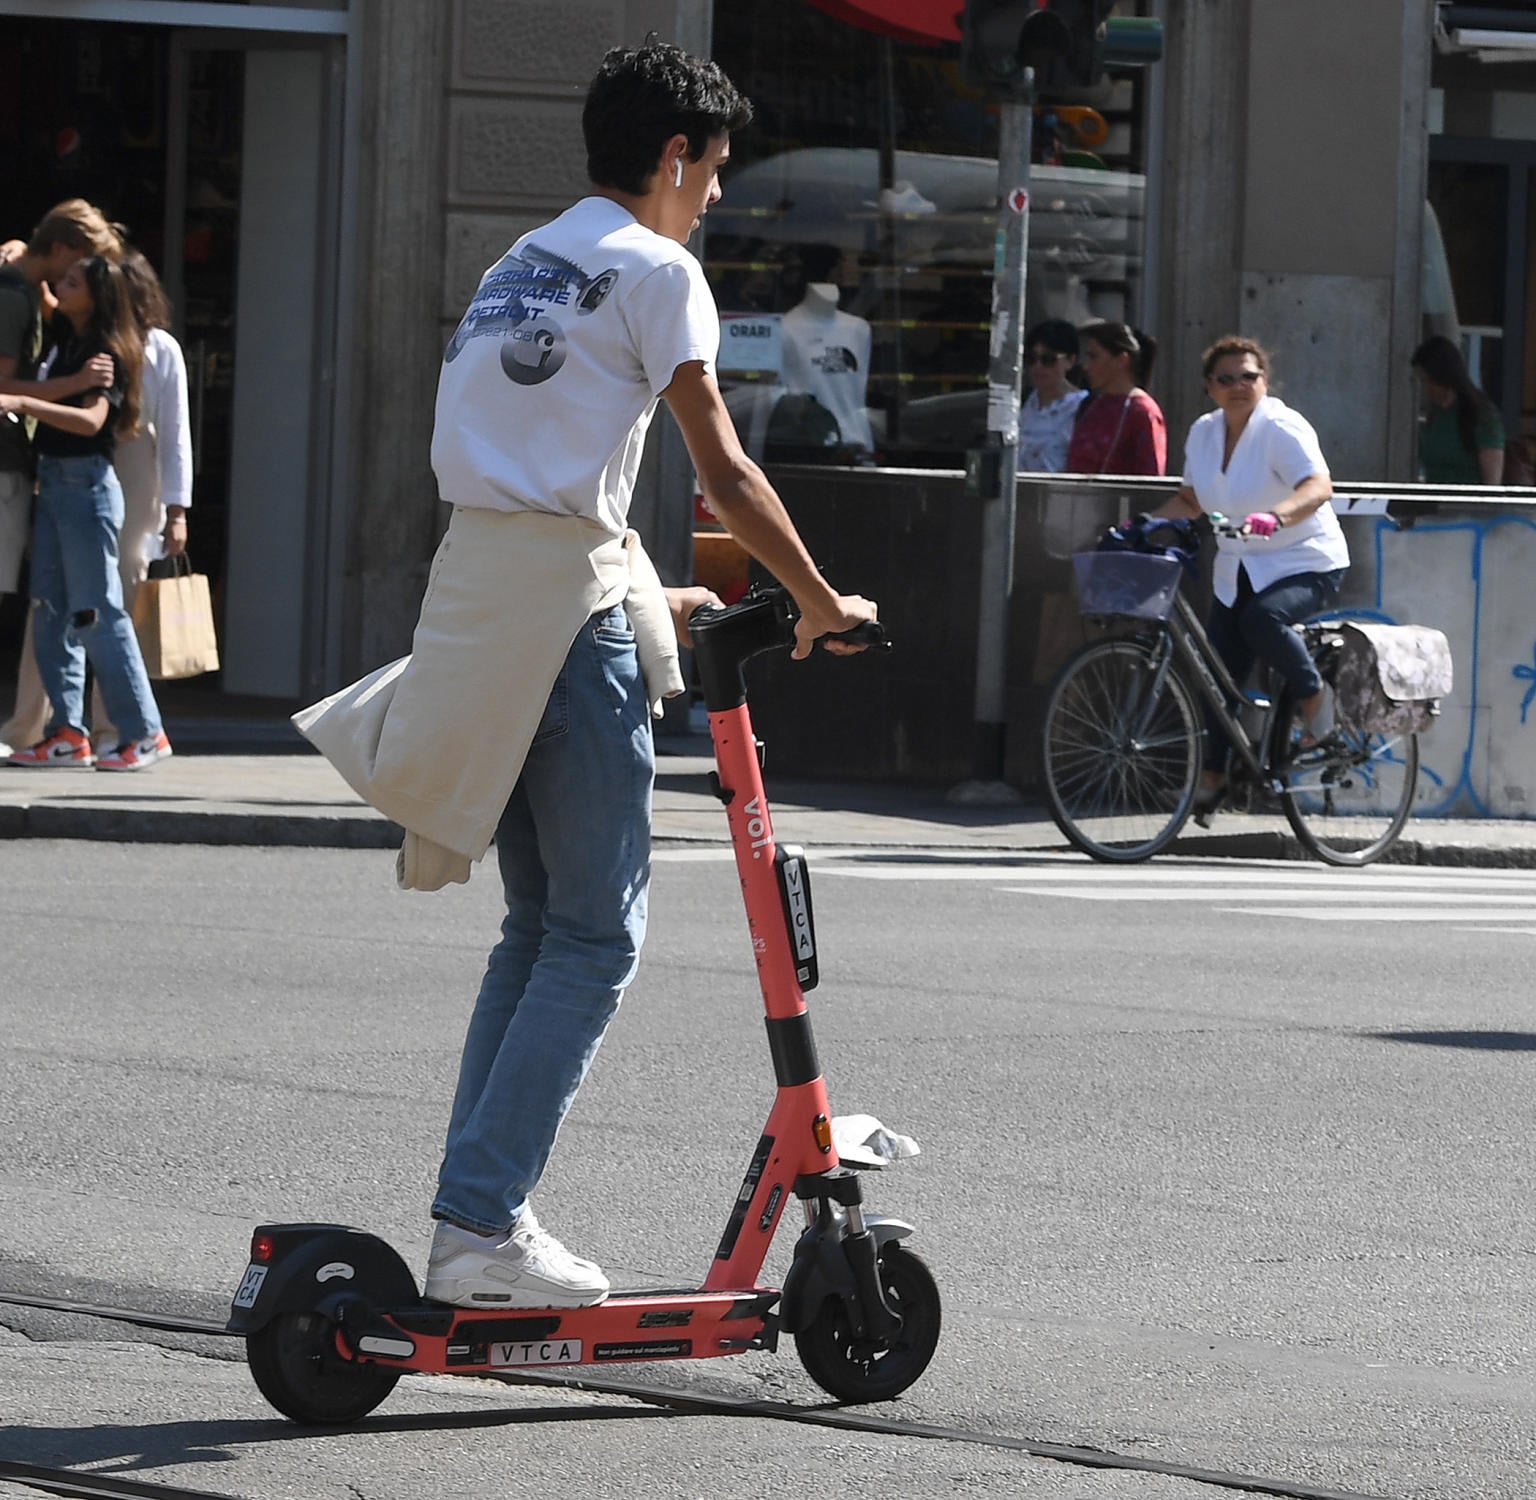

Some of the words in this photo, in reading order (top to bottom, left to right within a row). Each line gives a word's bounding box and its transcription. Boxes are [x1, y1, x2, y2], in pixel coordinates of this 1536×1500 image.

[730, 324, 771, 338] ORARI
[787, 870, 810, 950] VTCA
[247, 1270, 264, 1288] VT
[239, 1286, 256, 1302] CA
[501, 1343, 571, 1363] VTCA
